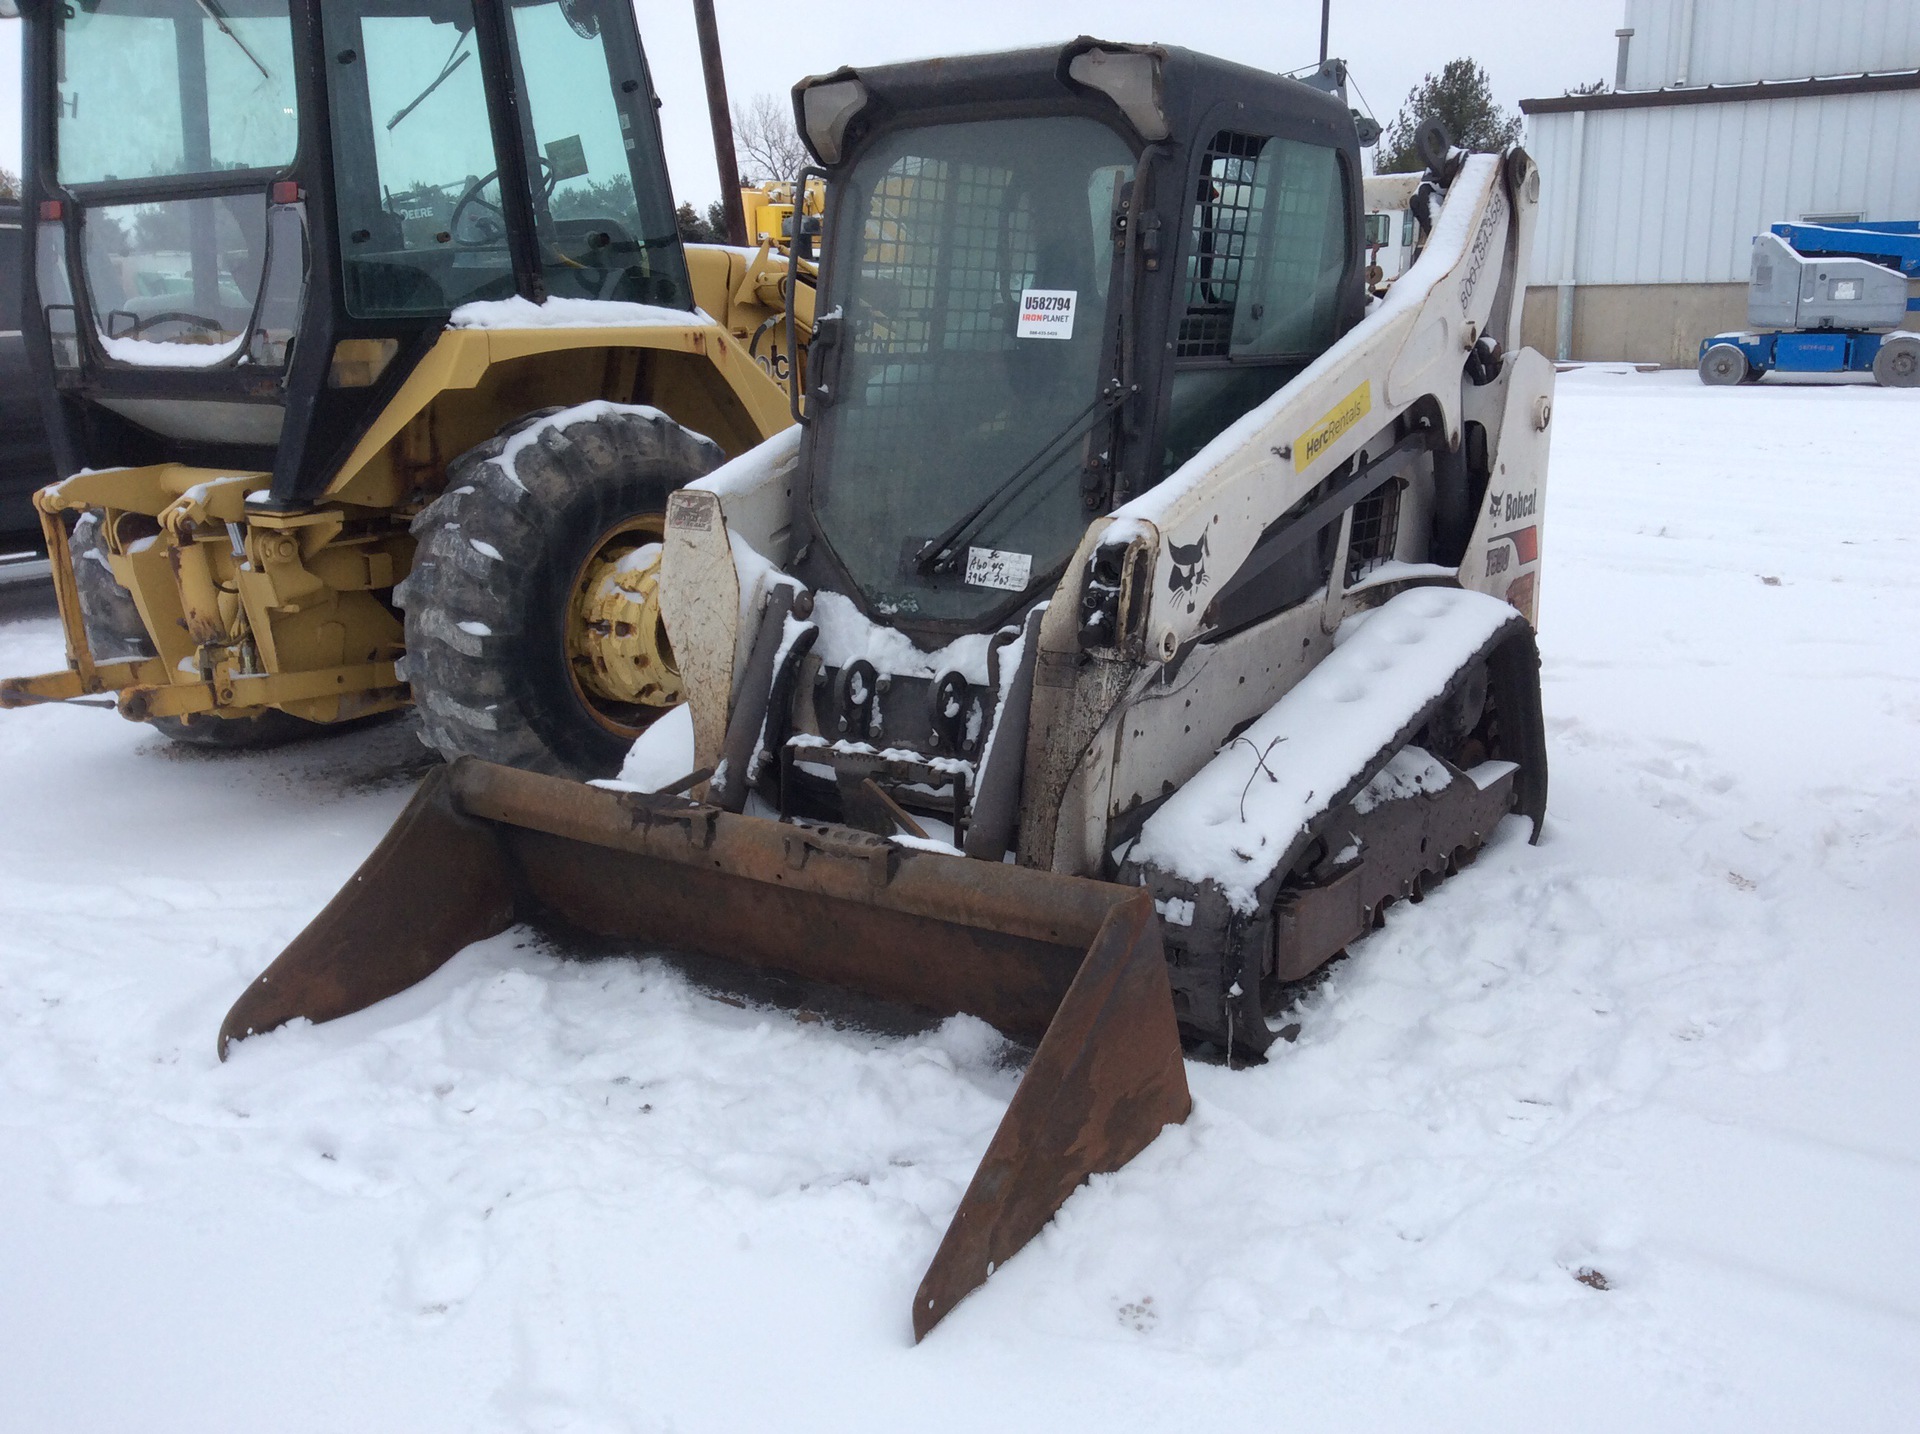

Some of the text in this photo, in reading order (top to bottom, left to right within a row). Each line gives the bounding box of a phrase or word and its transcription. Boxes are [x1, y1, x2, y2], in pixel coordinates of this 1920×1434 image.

[1025, 296, 1071, 311] U582794
[1022, 313, 1069, 323] IRONPLANET
[1505, 488, 1537, 522] Bobcat
